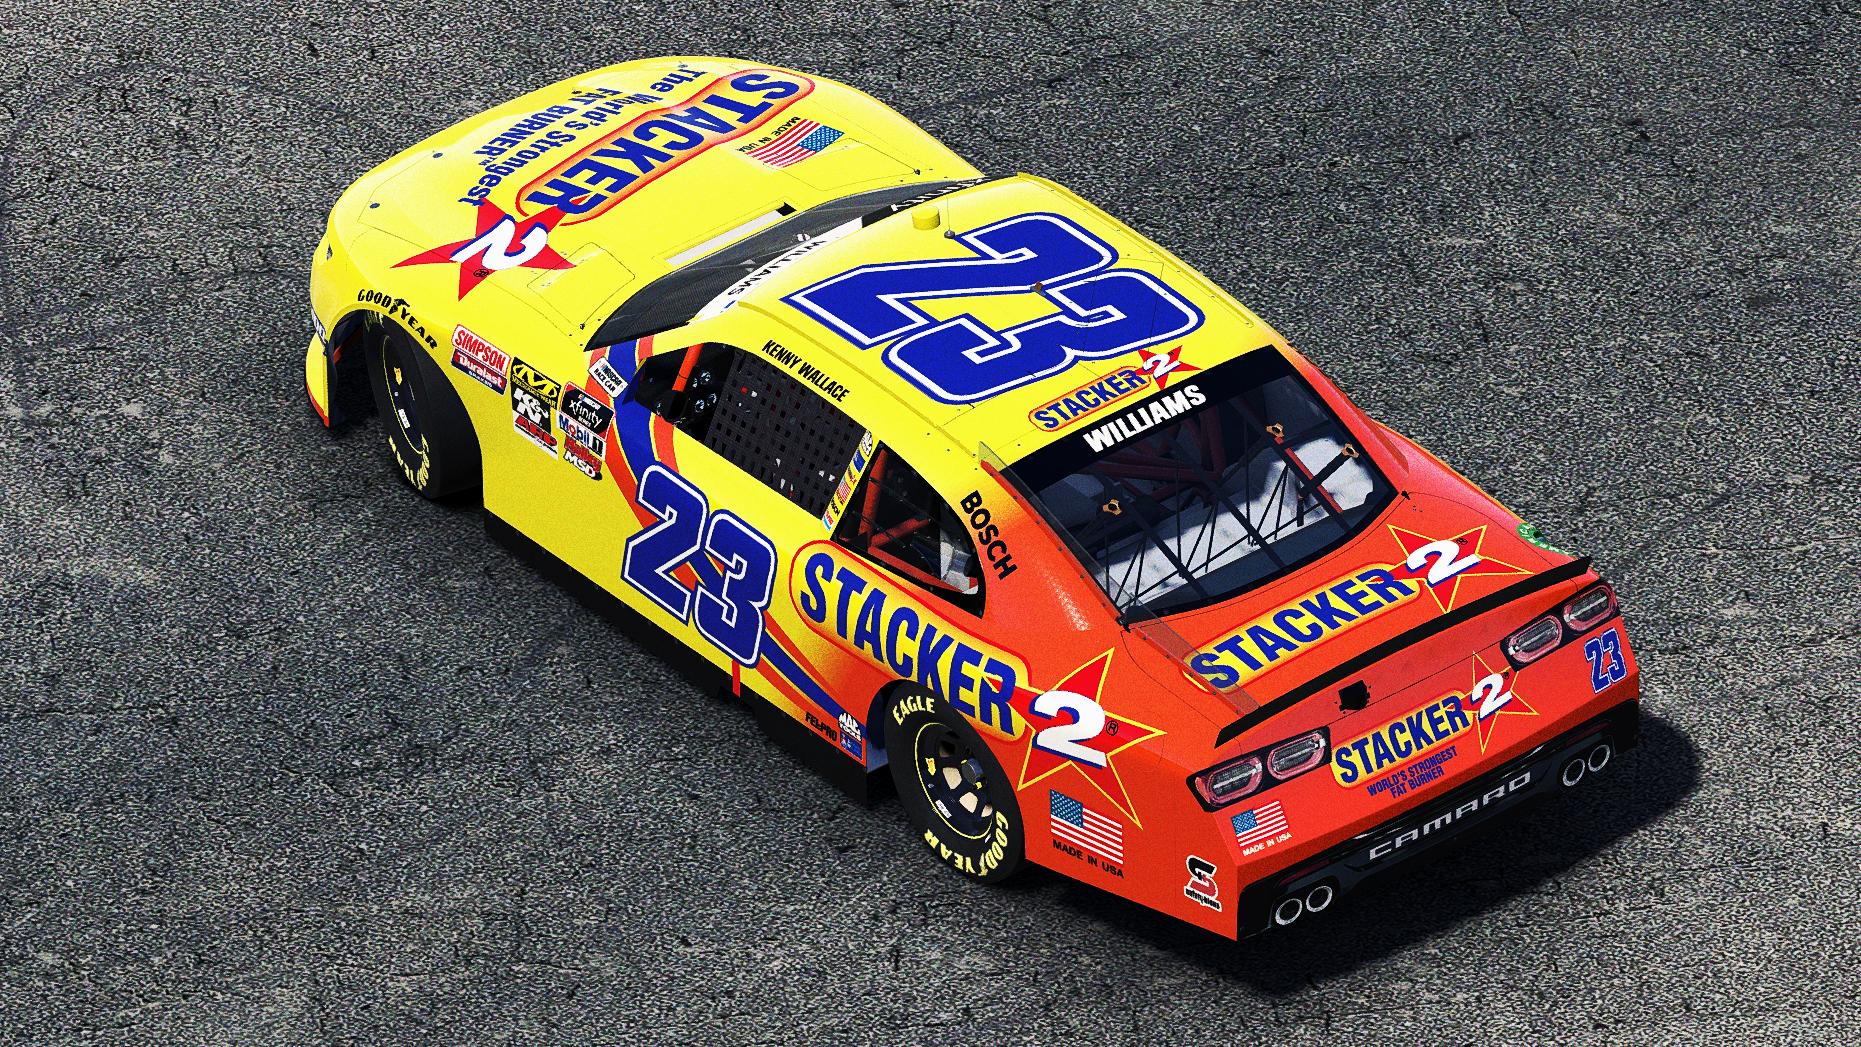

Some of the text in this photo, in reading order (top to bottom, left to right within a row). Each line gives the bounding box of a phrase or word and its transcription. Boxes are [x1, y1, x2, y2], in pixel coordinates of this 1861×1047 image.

[458, 68, 708, 206] The World's Strongest
[525, 73, 800, 214] STACKER
[771, 116, 801, 137] MADE
[780, 211, 1206, 405] 23
[455, 329, 507, 372] SIMPSON
[457, 352, 504, 389] Duralast
[761, 339, 851, 403] KENNY WALLACE
[568, 399, 603, 429] xfinity
[604, 380, 617, 393] CAR
[1033, 369, 1148, 429] STACKER
[558, 414, 590, 448] Mobil
[1082, 384, 1207, 453] WILLIAMS
[564, 450, 596, 478] MSD
[620, 460, 778, 670] 23
[960, 489, 1019, 581] BOSCH
[800, 552, 1017, 736] STACKER
[1190, 568, 1416, 690] STACKER
[1583, 626, 1628, 695] 23
[892, 695, 936, 726] EAGLE
[1335, 695, 1471, 784] STACKER
[1366, 745, 1458, 797] WORLD'S STRONGEST
[1390, 765, 1445, 799] FAT BURNER
[1242, 831, 1293, 857] MADE IN USA
[1369, 770, 1532, 861] CAMARO
[1052, 838, 1125, 879] MADE IN USA
